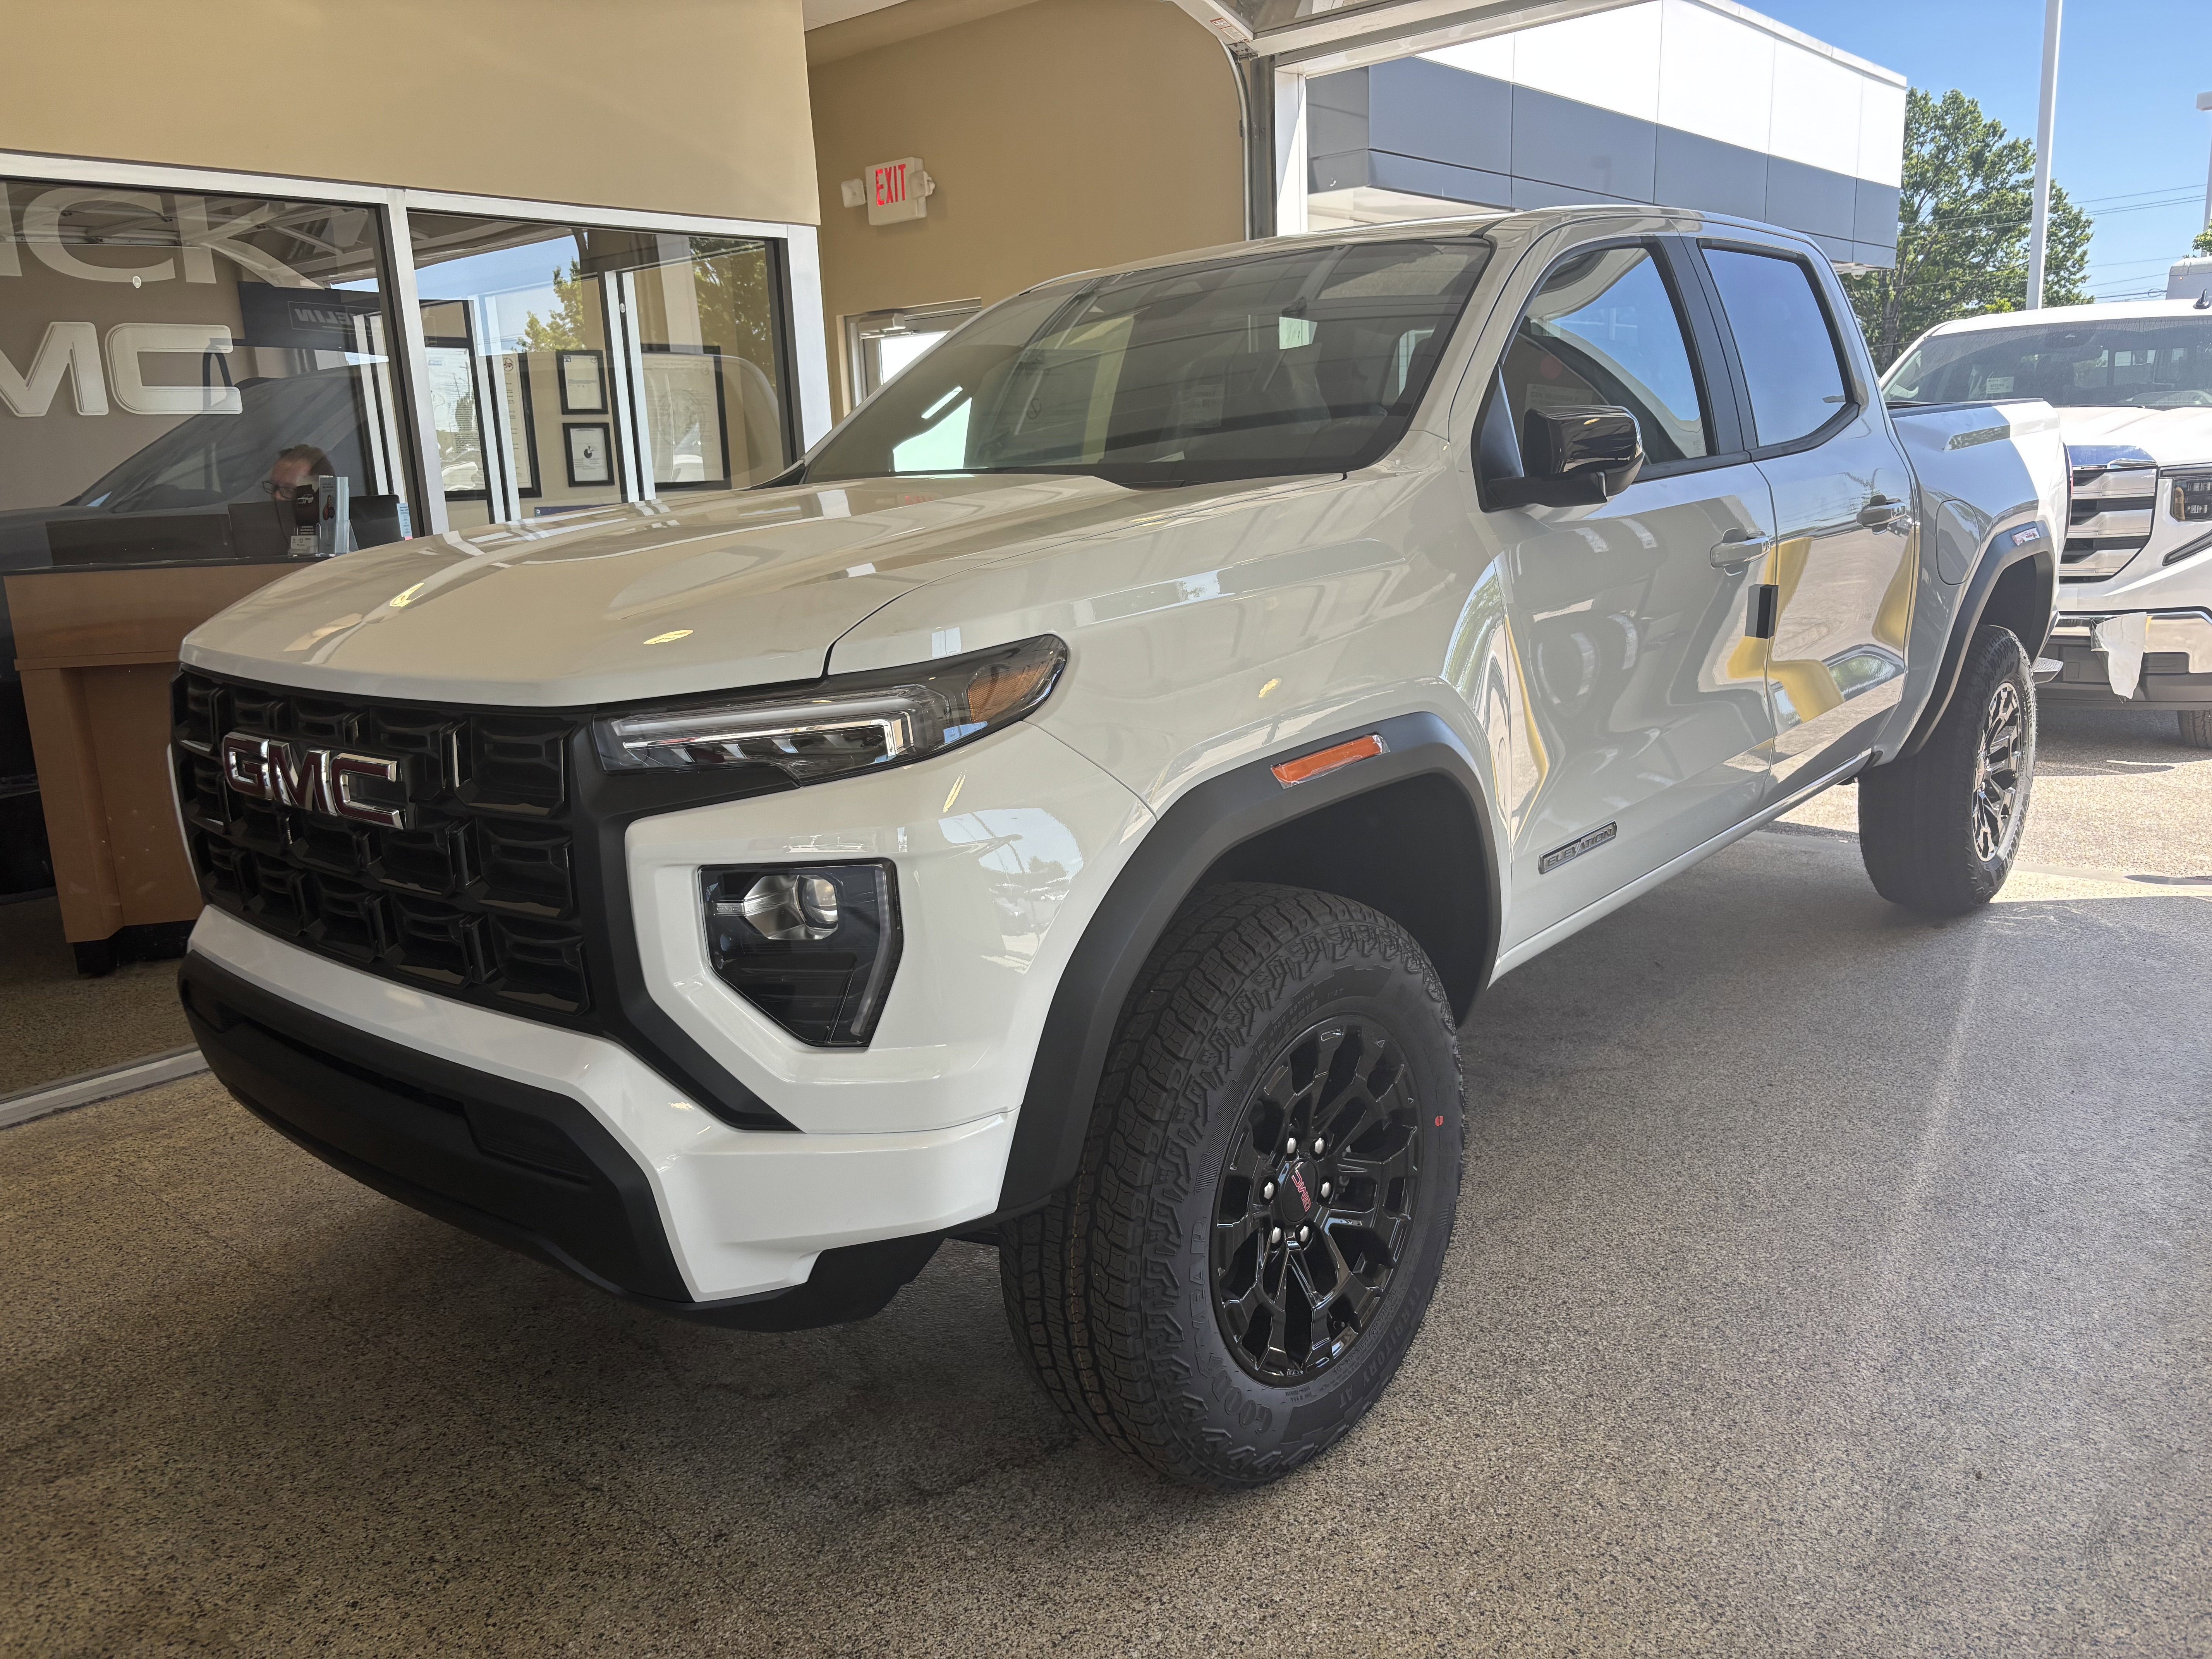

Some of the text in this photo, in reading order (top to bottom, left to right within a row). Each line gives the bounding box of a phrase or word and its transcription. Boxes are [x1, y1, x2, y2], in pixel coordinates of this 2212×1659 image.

[875, 163, 906, 206] EXIT
[222, 731, 404, 830] GMC
[1546, 828, 1613, 867] ELEVATION
[1291, 1170, 1312, 1212] GMC
